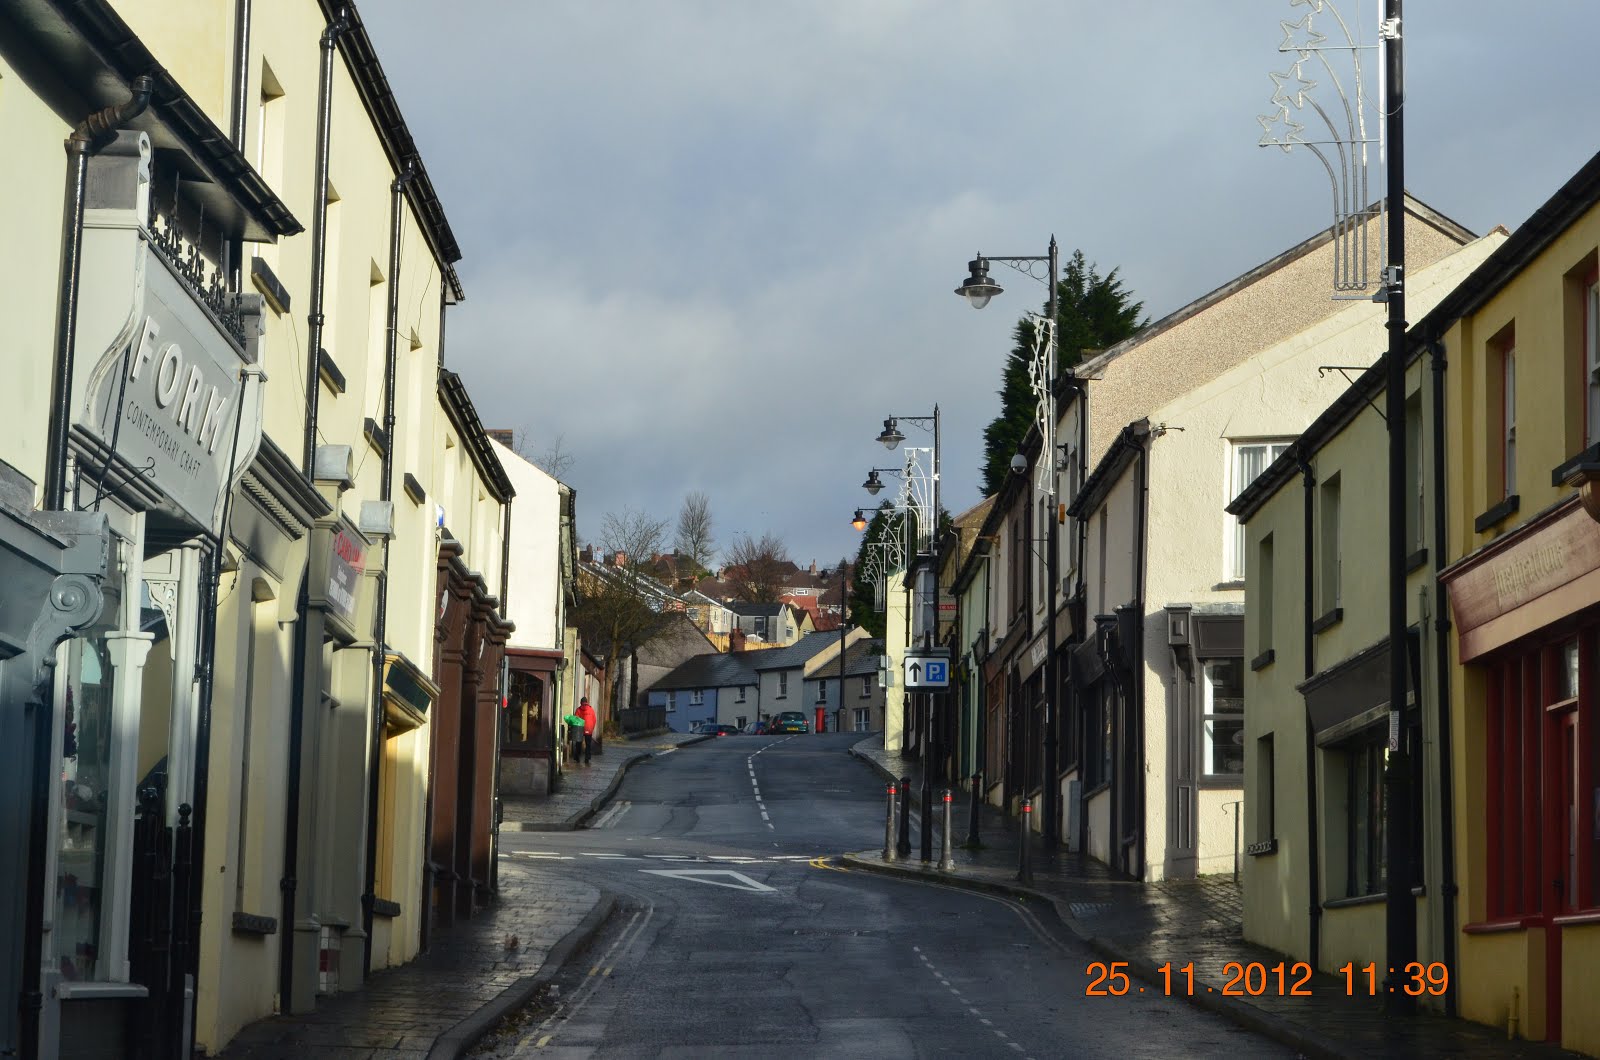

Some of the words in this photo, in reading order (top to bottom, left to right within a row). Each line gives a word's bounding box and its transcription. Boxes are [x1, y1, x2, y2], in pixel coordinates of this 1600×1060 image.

[131, 315, 227, 456] FORM
[126, 400, 181, 463] CONTEMPORARY
[179, 450, 201, 480] CRAFT
[929, 664, 940, 680] P
